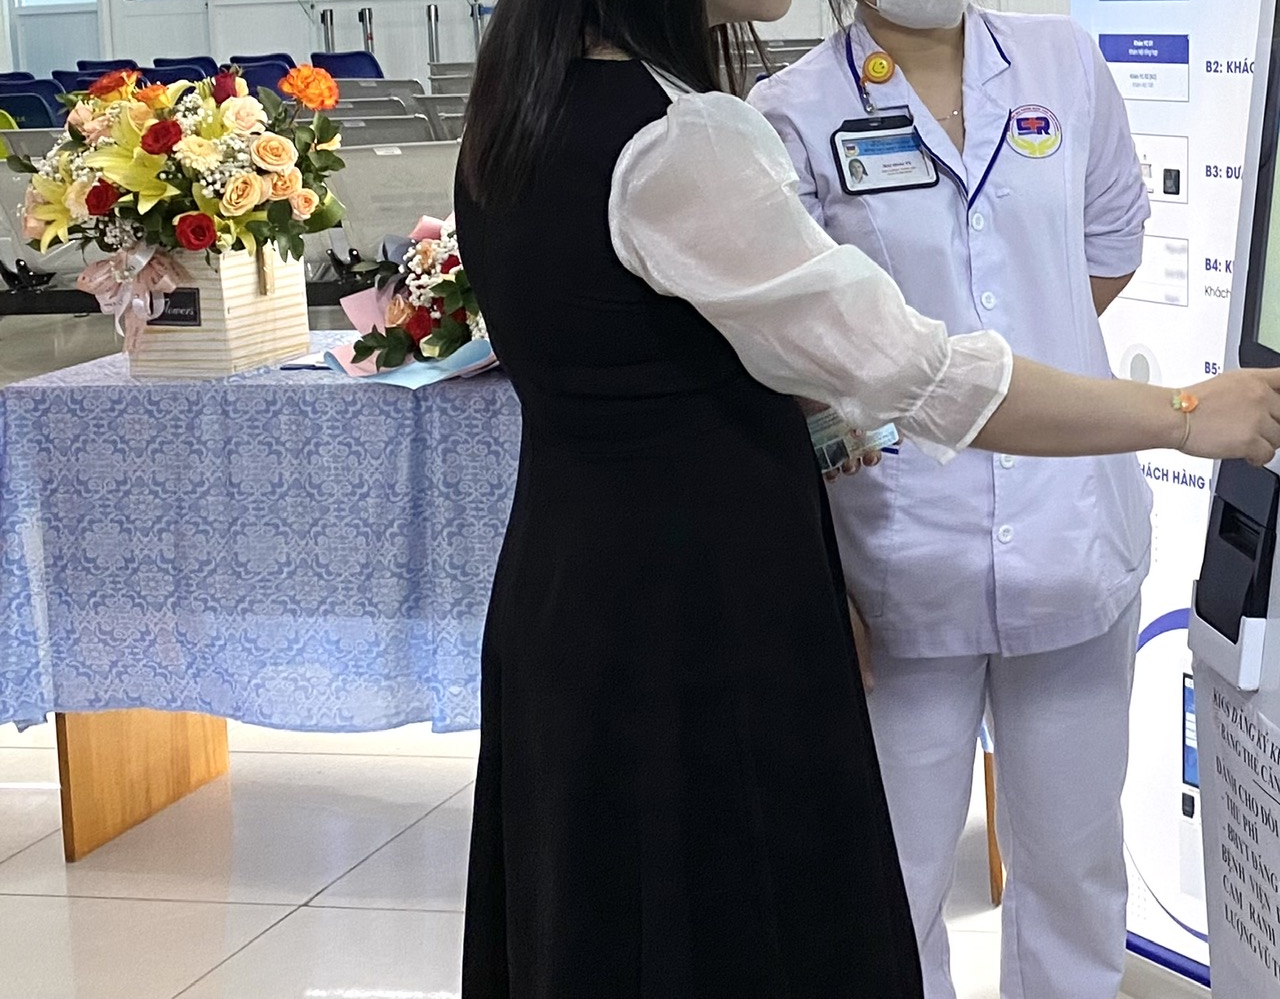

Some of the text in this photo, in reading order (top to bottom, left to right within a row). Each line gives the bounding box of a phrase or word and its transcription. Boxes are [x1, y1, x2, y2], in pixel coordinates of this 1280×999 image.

[1205, 60, 1223, 74] B2:
[1205, 165, 1243, 180] B3: ĐƯ
[1204, 257, 1222, 273] B4:
[1204, 361, 1221, 376] B5:
[1172, 468, 1206, 490] HÀNG
[1256, 728, 1270, 754] KÝ
[1238, 783, 1259, 818] CHO
[1222, 873, 1244, 911] CAM
[1248, 900, 1277, 948] RANH
